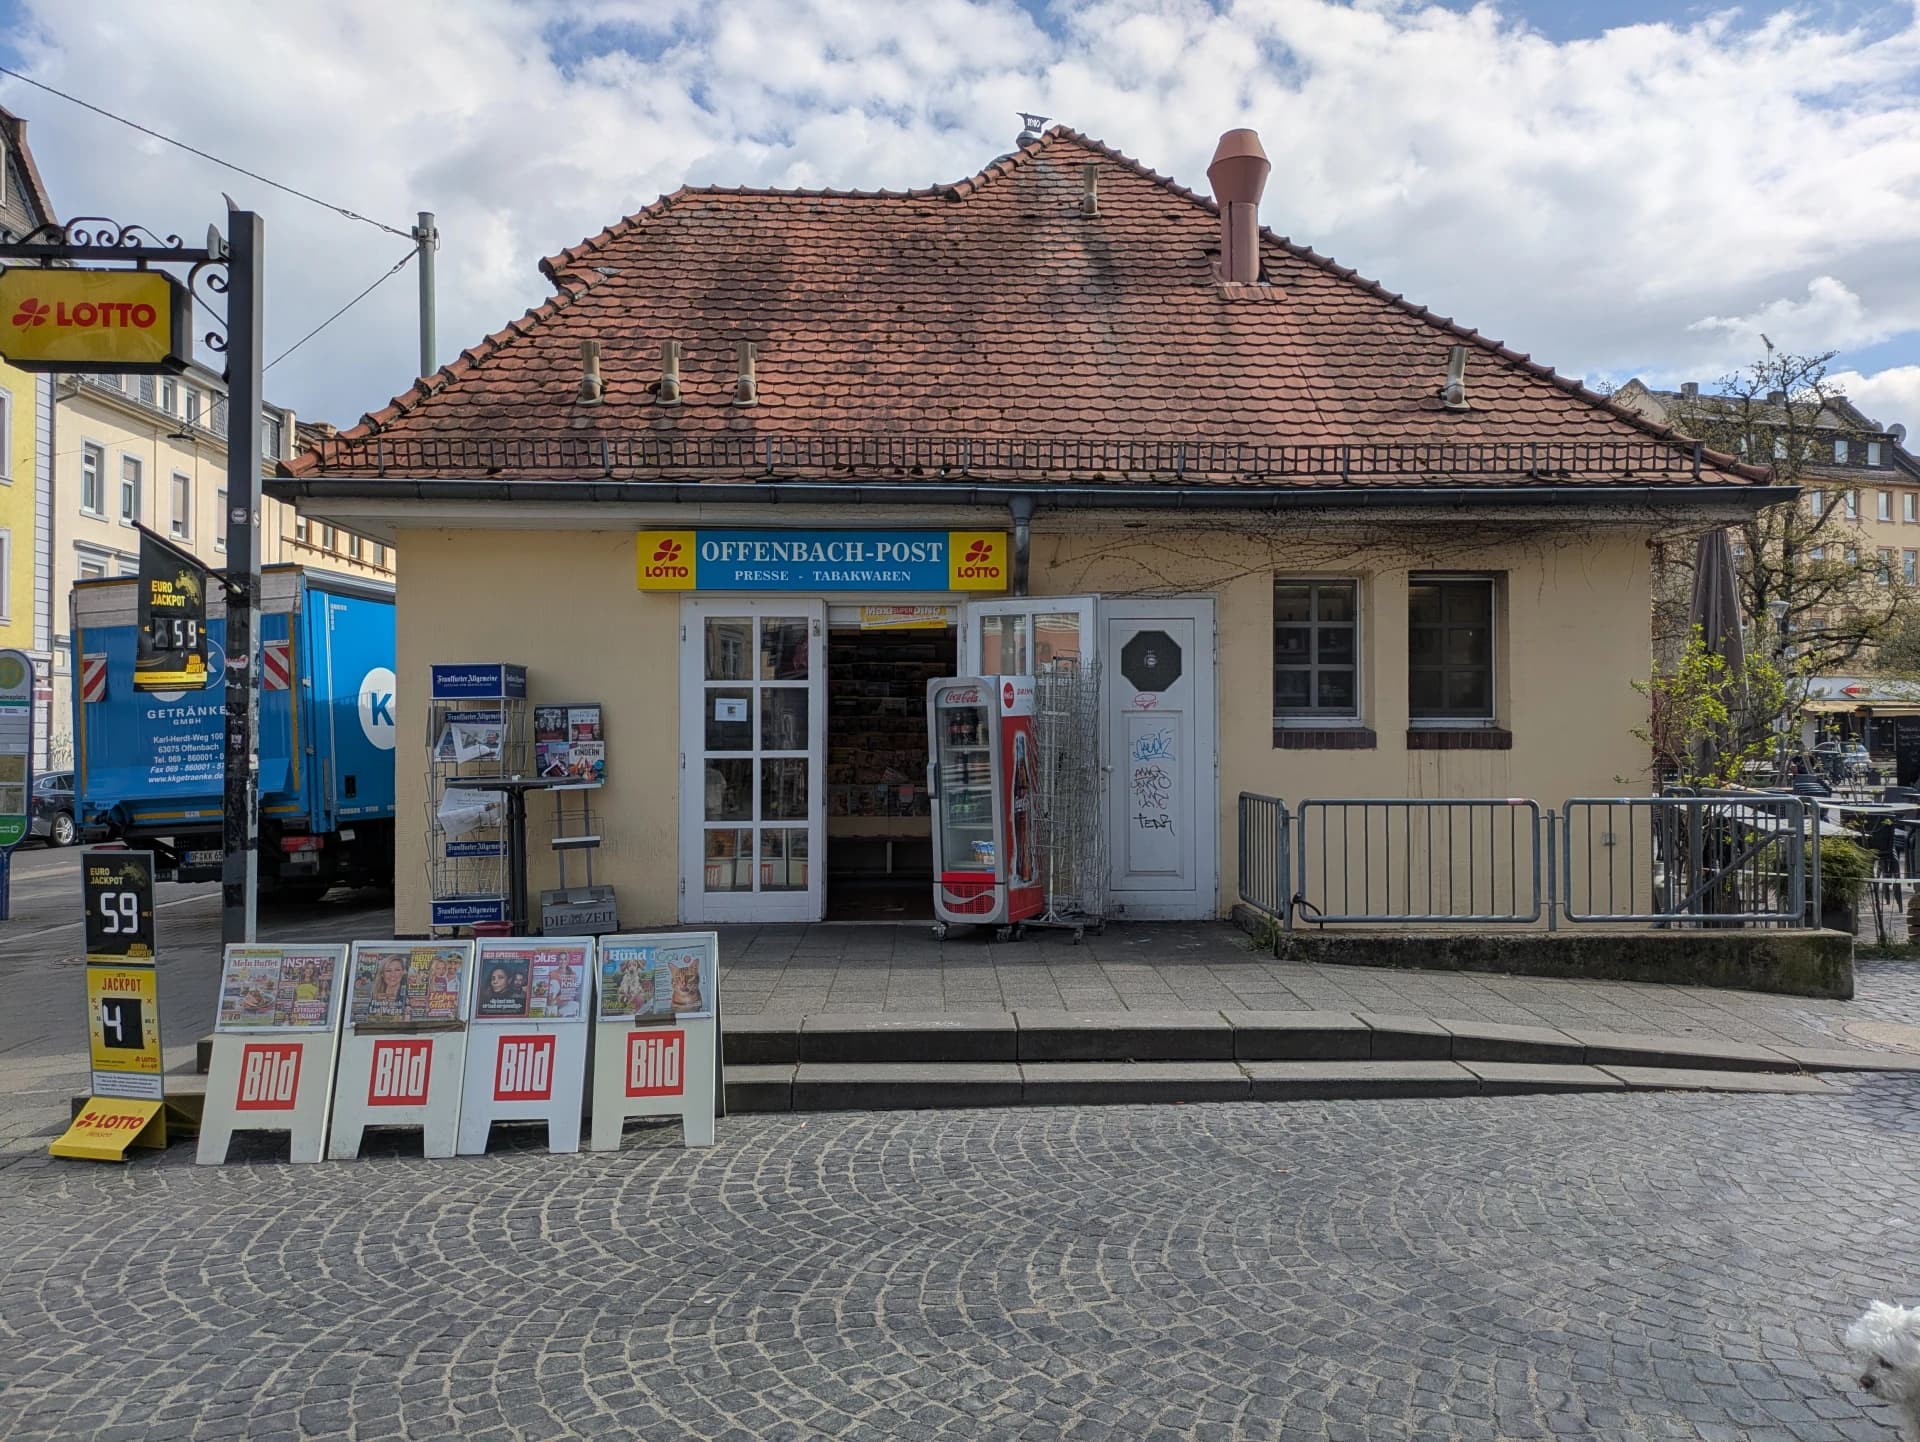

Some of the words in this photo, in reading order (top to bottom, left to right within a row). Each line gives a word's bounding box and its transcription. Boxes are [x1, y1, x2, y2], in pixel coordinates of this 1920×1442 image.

[57, 302, 156, 328] LOTTO
[701, 541, 944, 563] OFFENBACH-POST
[645, 566, 689, 578] LOTTO
[734, 570, 789, 582] PRESSE
[813, 570, 912, 582] TABAKWAREN
[957, 566, 1000, 578] LOTTO
[151, 580, 173, 593] EURO
[150, 594, 186, 607] JACKPOT
[147, 706, 226, 719] GETRÄNKE
[371, 692, 395, 726] K
[181, 744, 219, 753] Offenbach
[154, 756, 166, 764] Tel.
[150, 766, 163, 774] Fax
[90, 867, 110, 876] EURO
[90, 877, 124, 885] JACKPOT
[100, 892, 138, 934] 59
[544, 915, 568, 928] DIE
[585, 912, 615, 924] ZEIT
[102, 977, 141, 992] JACKPOT
[103, 1005, 122, 1042] 4
[499, 1043, 550, 1092] Bild
[631, 1039, 679, 1088] Bild
[243, 1052, 297, 1101] Bild
[374, 1048, 427, 1096] Bild
[96, 1115, 145, 1130] LOTTO
